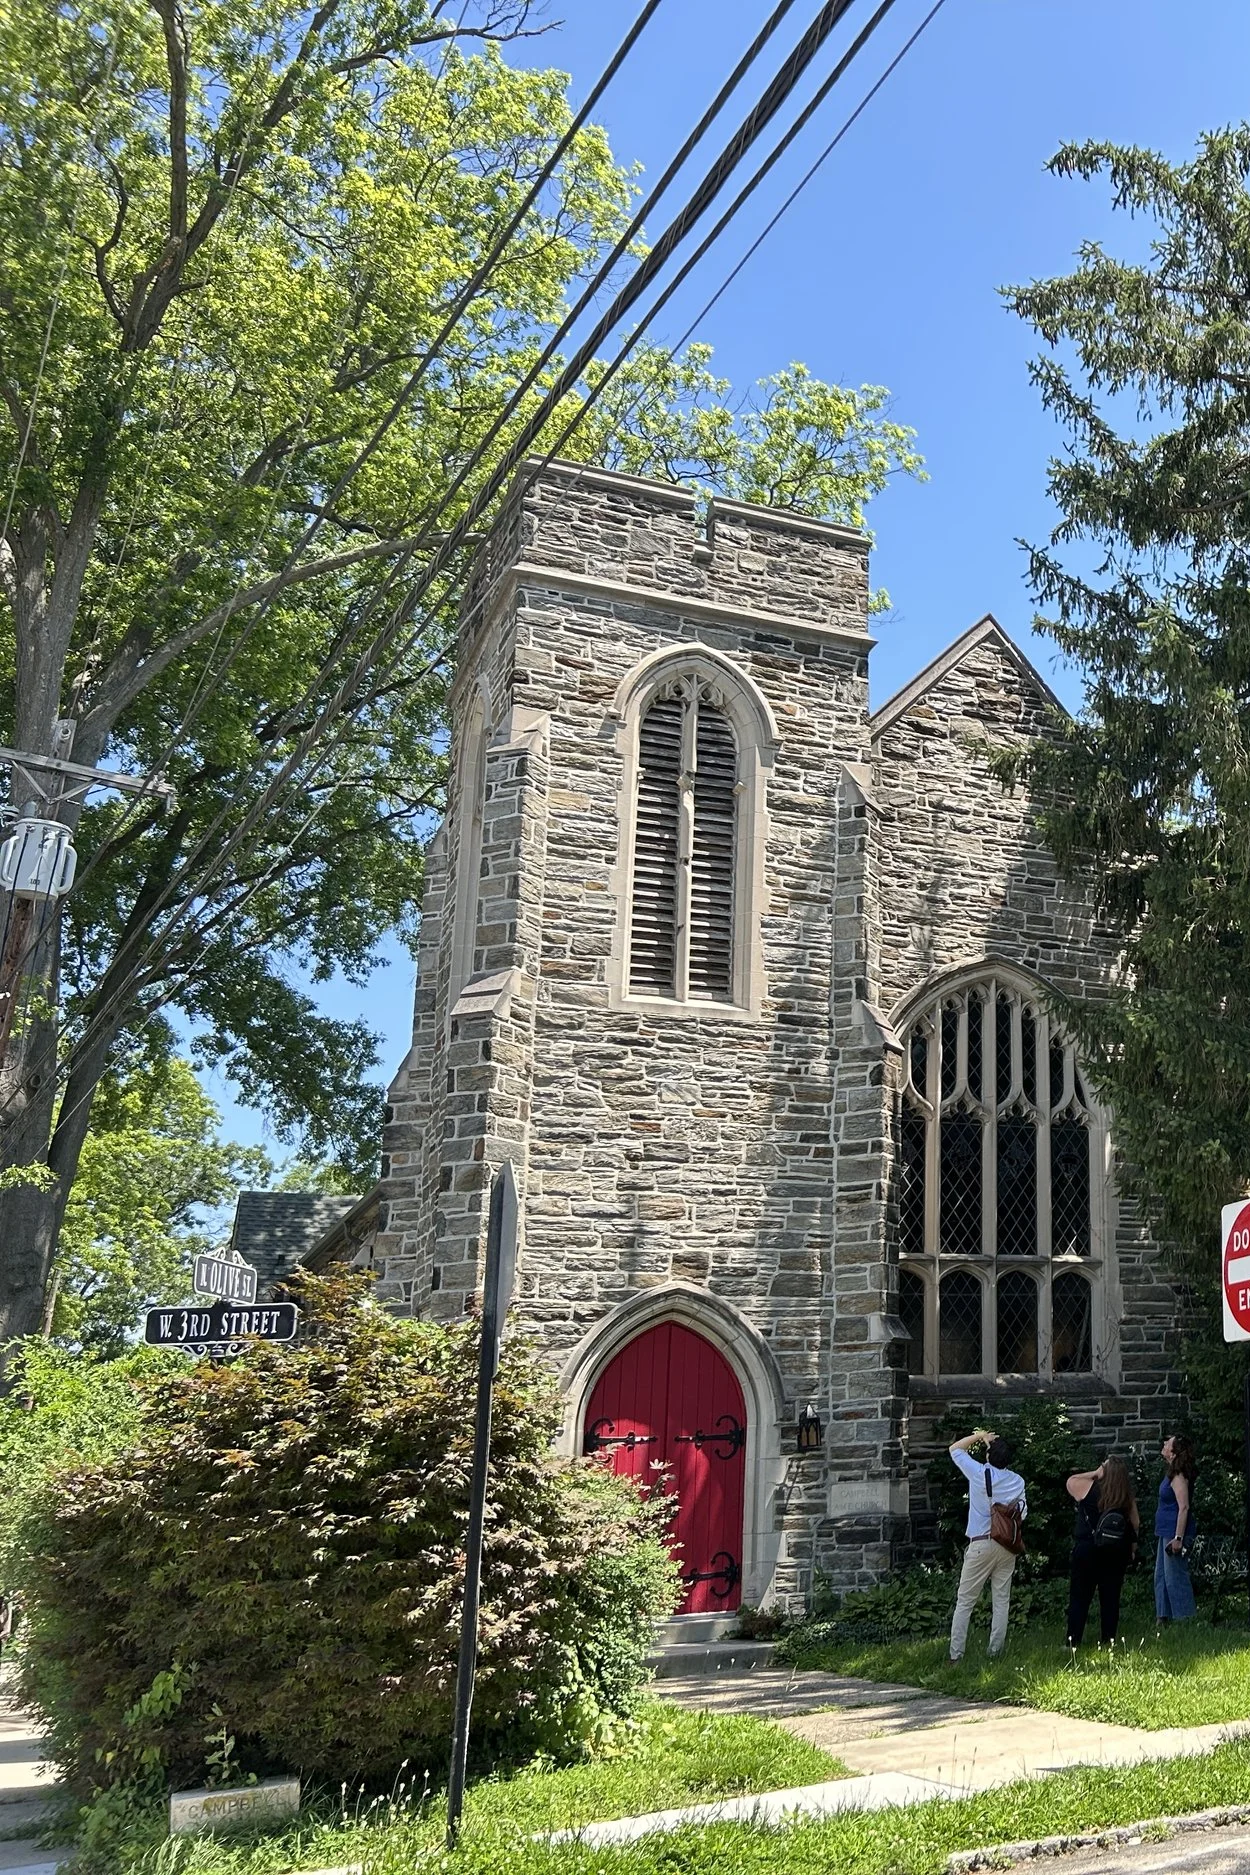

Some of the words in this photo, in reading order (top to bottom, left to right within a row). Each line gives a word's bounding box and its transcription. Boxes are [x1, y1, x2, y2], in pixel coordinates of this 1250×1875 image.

[1233, 1228, 1250, 1252] DO
[210, 1262, 241, 1298] OLIVE
[159, 1314, 174, 1339] W.
[177, 1311, 211, 1341] 3RD
[220, 1311, 281, 1336] STREET
